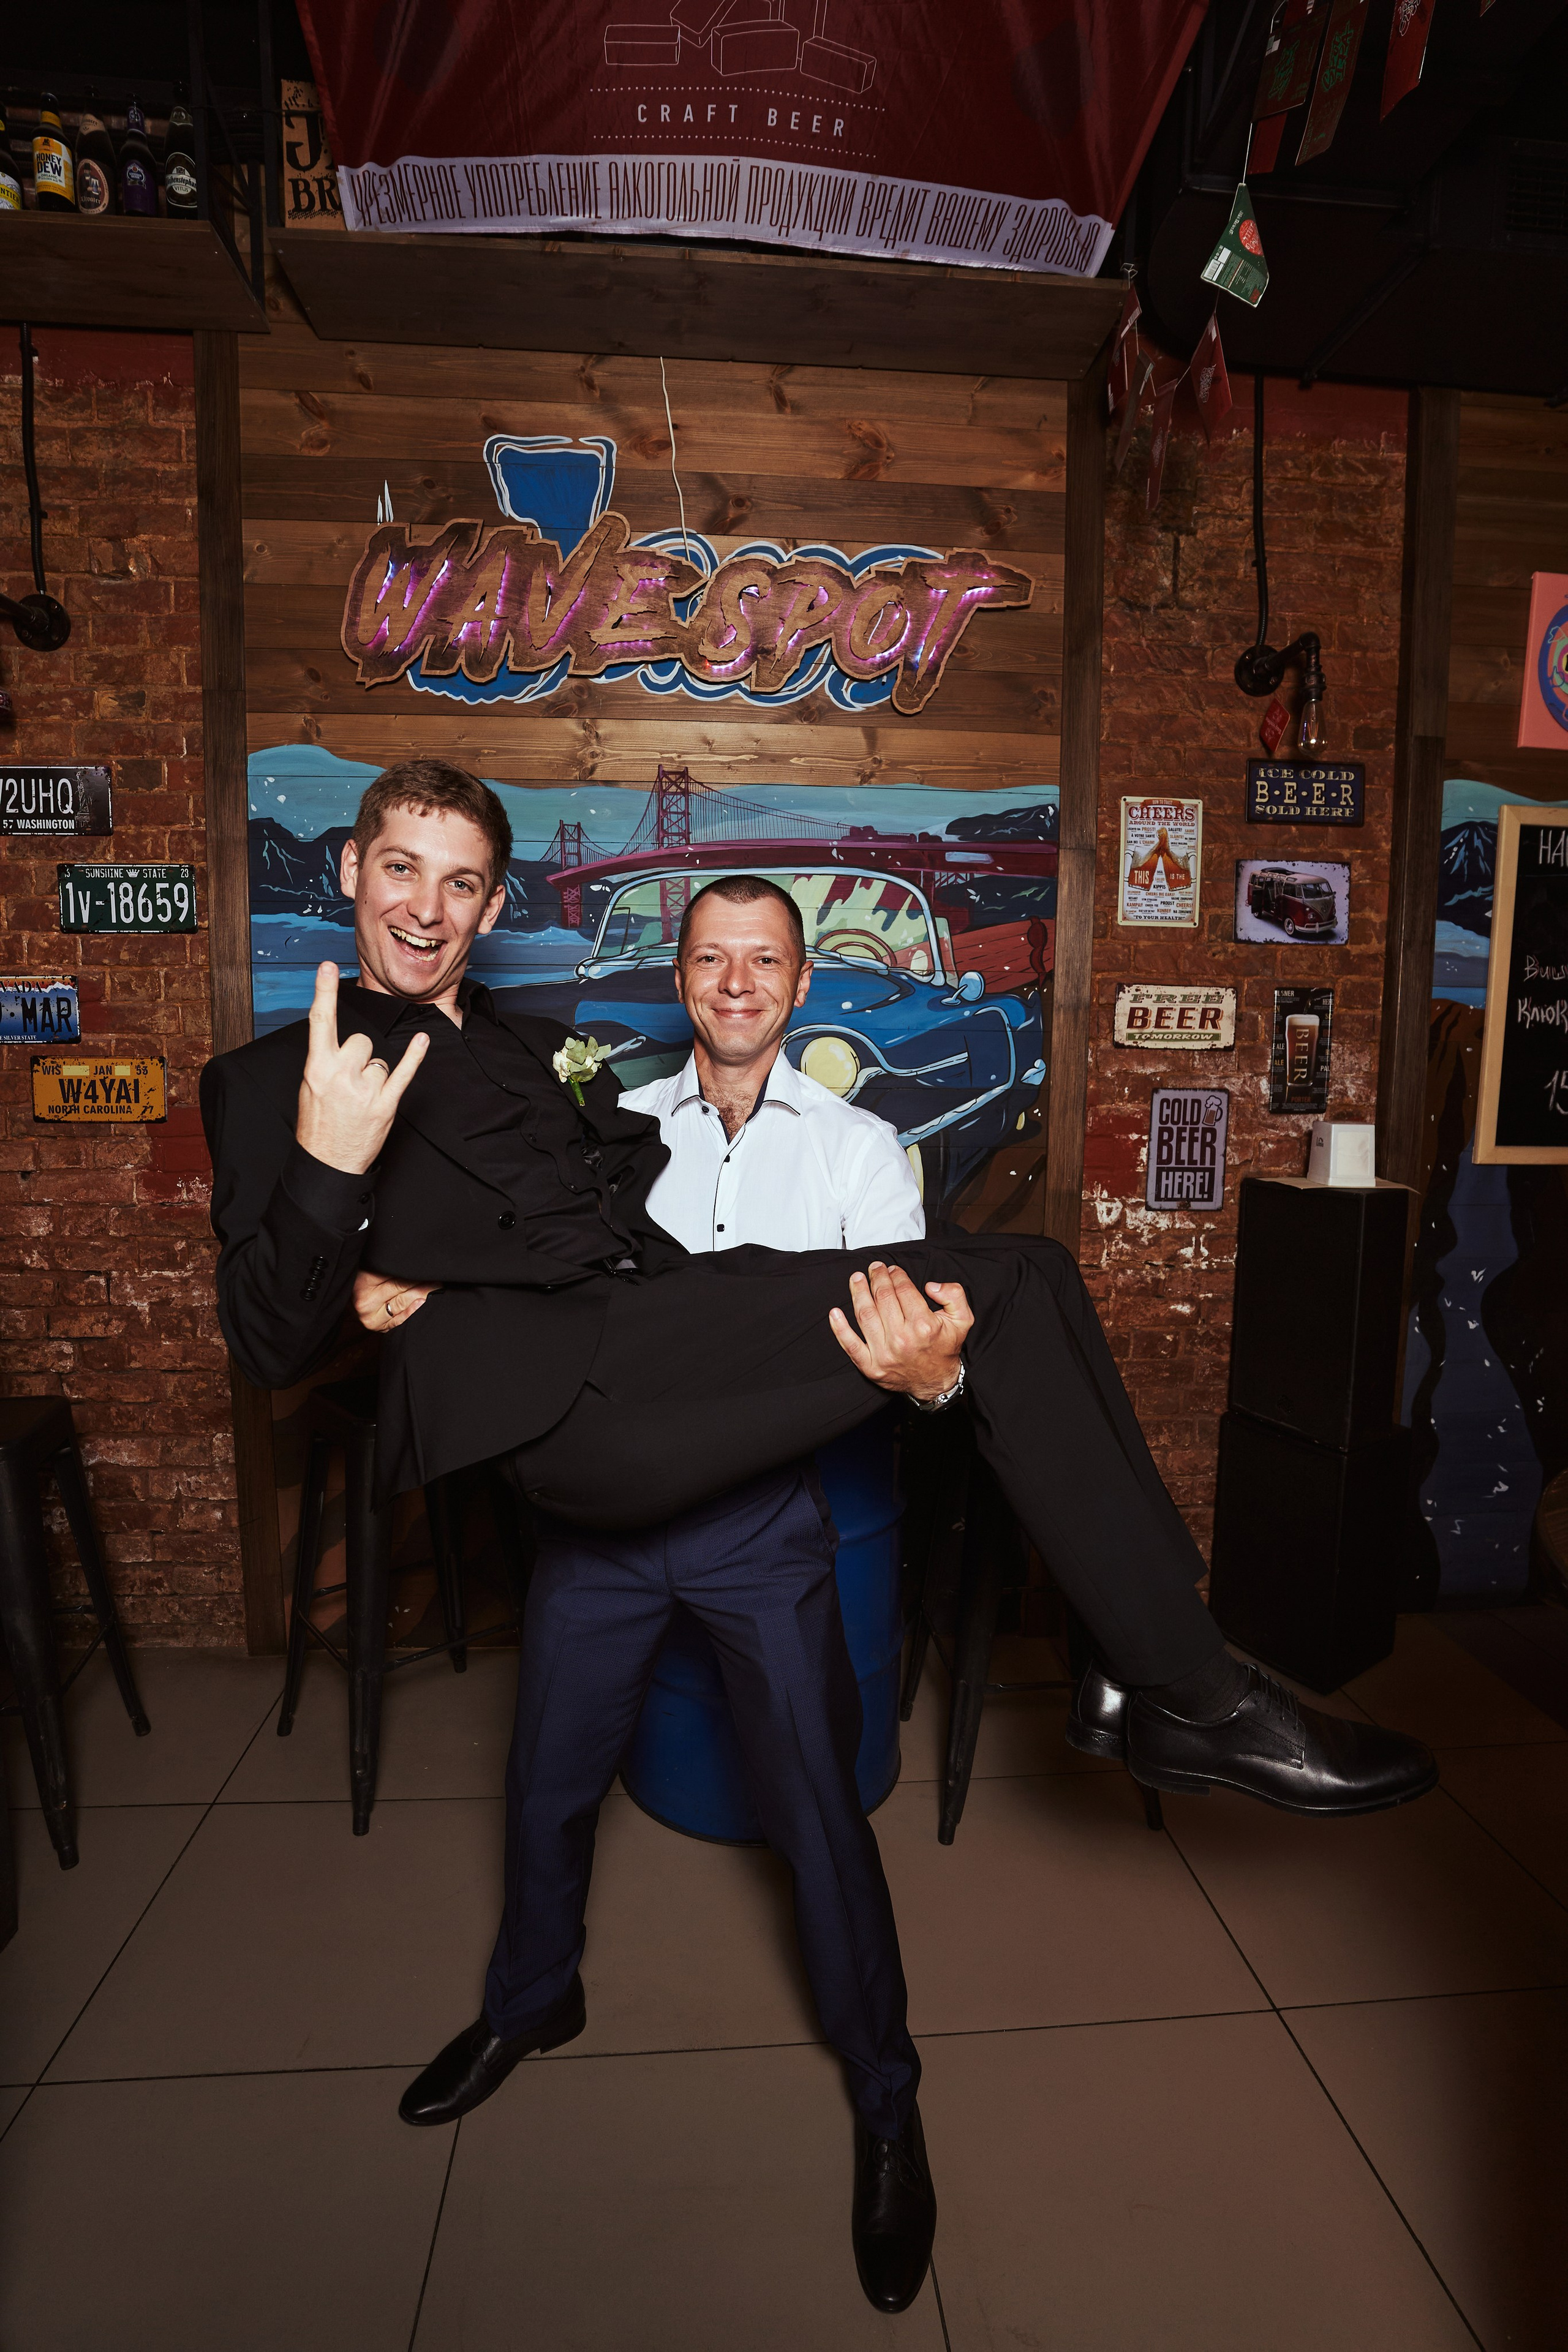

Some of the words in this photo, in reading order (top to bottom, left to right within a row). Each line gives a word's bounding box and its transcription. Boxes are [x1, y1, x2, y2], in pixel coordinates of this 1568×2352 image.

[638, 104, 738, 123] CRAFT
[767, 108, 845, 137] BEER
[37, 153, 61, 165] HONEY
[37, 161, 62, 176] DEW
[351, 163, 466, 227] ЧРЕЗМЕРНОЕ
[464, 161, 602, 219] УПОТРЕБЛЕНИЕ
[609, 158, 741, 223] АЛКОГОЛЬНОЙ
[744, 164, 859, 241] ПРОДУКЦИИ
[855, 181, 932, 250] ВРЕДИТ
[925, 190, 1013, 254] ВАШЕМУ
[1003, 203, 1101, 274] ЗДОРОВЬЮ
[356, 527, 682, 660] WAVE
[696, 566, 1020, 697] SPOT
[1257, 768, 1295, 778] ICE
[1298, 770, 1355, 781] COLD
[1128, 806, 1195, 821] CHEERS
[1256, 805, 1301, 815] SOLD
[1304, 806, 1355, 817] HERE
[3, 819, 13, 829] 57
[17, 819, 75, 829] WASHINGTON
[85, 869, 124, 878] SUNSHINE
[143, 869, 167, 878] STATE
[1134, 870, 1150, 884] THIS
[1129, 993, 1224, 1004] FREE
[1126, 1006, 1224, 1030] BEER
[1294, 1028, 1309, 1082] BEER
[42, 1065, 61, 1075] WIS
[94, 1066, 112, 1075] JAN
[48, 1105, 80, 1114] NORTH
[83, 1105, 133, 1114] CAROLINA
[1159, 1098, 1202, 1126] COLD
[1156, 1126, 1218, 1166] BEER
[1160, 1171, 1210, 1199] HERE!
